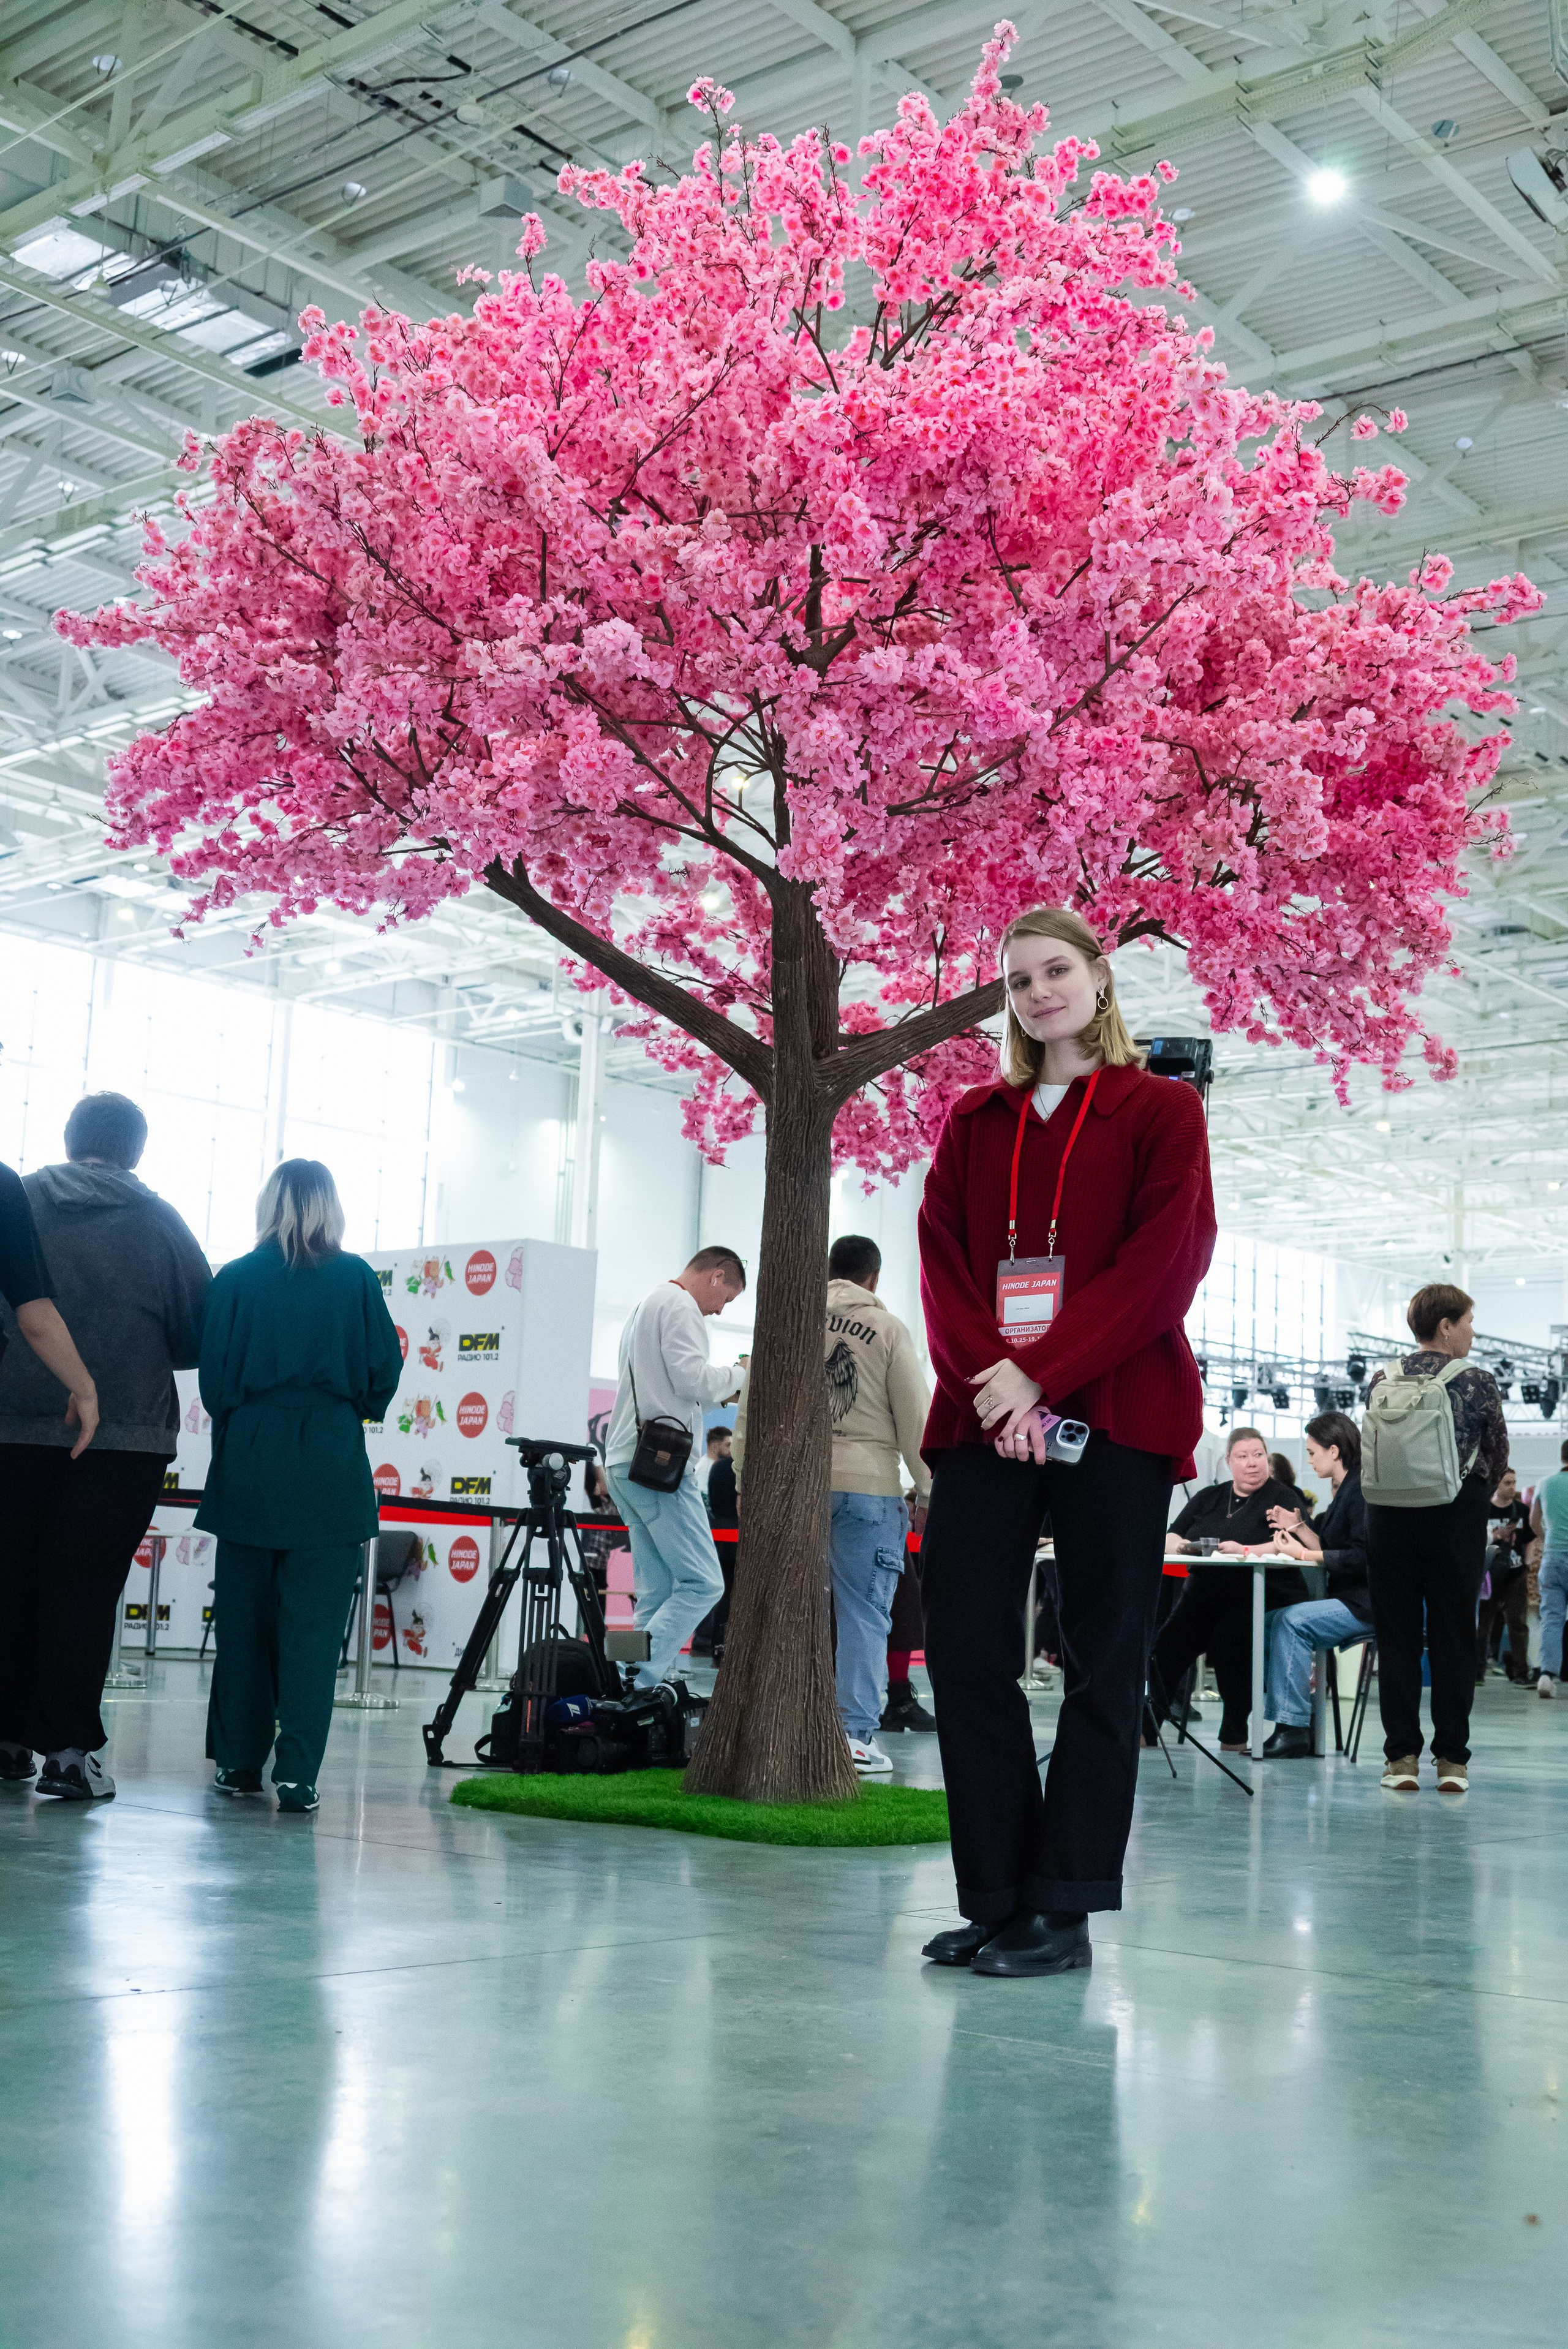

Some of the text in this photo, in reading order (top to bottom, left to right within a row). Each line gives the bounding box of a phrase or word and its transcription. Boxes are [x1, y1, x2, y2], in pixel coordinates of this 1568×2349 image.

[468, 1262, 494, 1272] HINODE
[467, 1273, 492, 1284] JAPAN
[1002, 1279, 1057, 1291] HINODE JAPAN
[827, 1314, 878, 1345] vion
[459, 1333, 499, 1351] DFM
[459, 1405, 486, 1415] HINODE
[459, 1416, 483, 1426] JAPAN
[451, 1477, 491, 1494] DFM
[451, 1549, 478, 1559] HINODE
[451, 1561, 475, 1570] JAPAN
